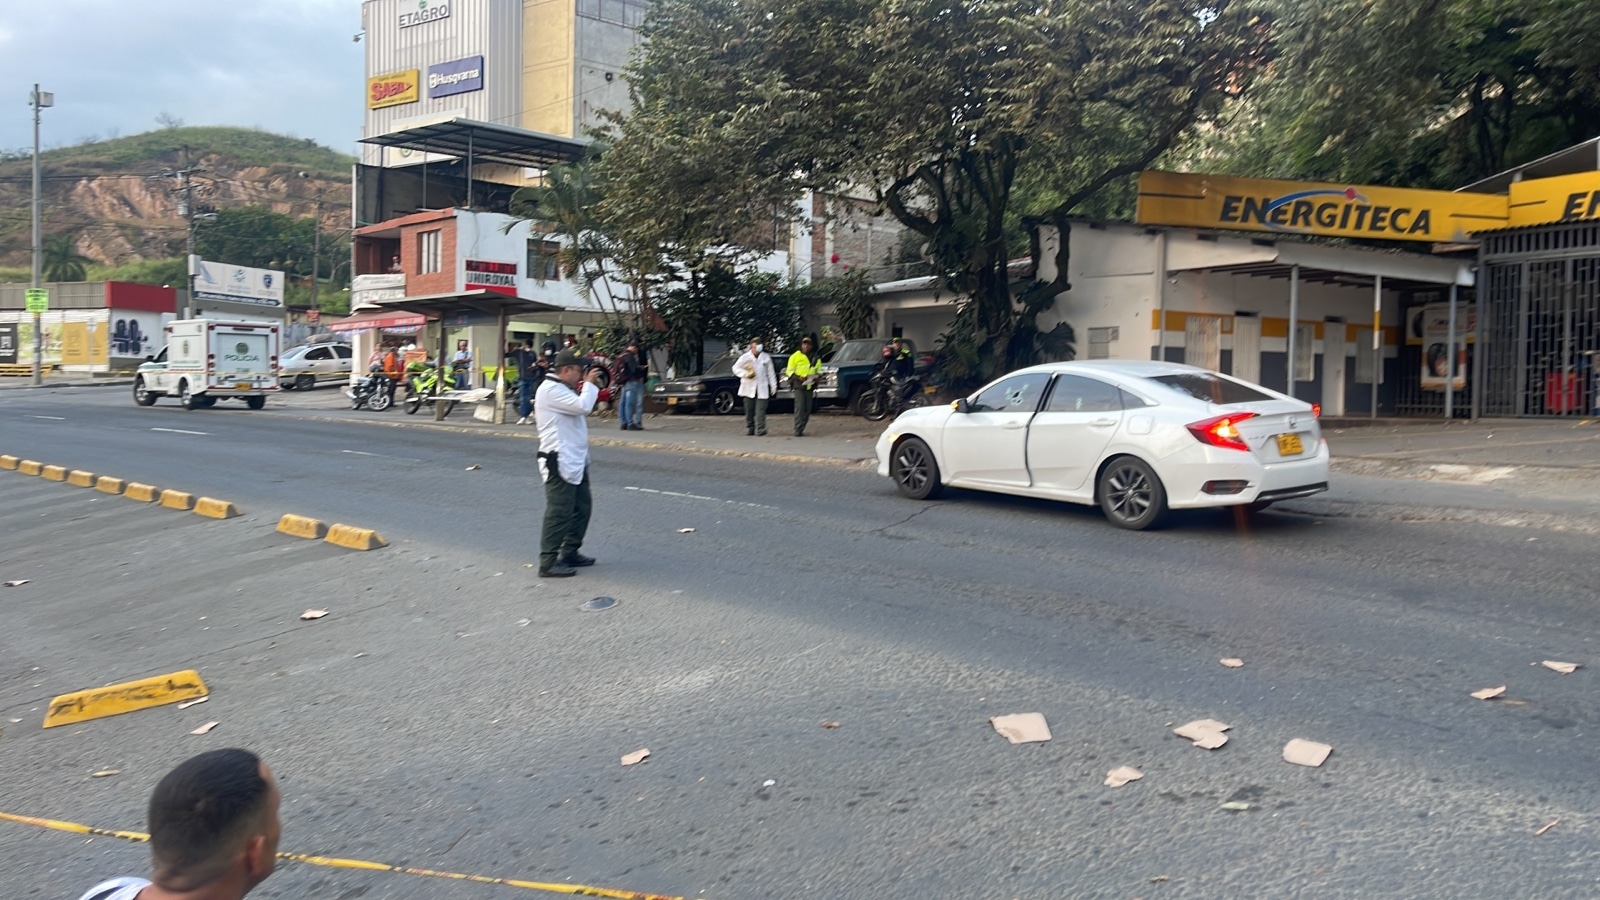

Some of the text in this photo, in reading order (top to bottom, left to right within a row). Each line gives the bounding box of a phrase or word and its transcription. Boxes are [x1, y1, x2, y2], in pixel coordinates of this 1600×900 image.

[399, 4, 448, 26] ETAGRO
[438, 69, 479, 85] Husqvarna
[1219, 195, 1431, 235] ENERGITECA
[466, 272, 516, 287] UNIROYAL
